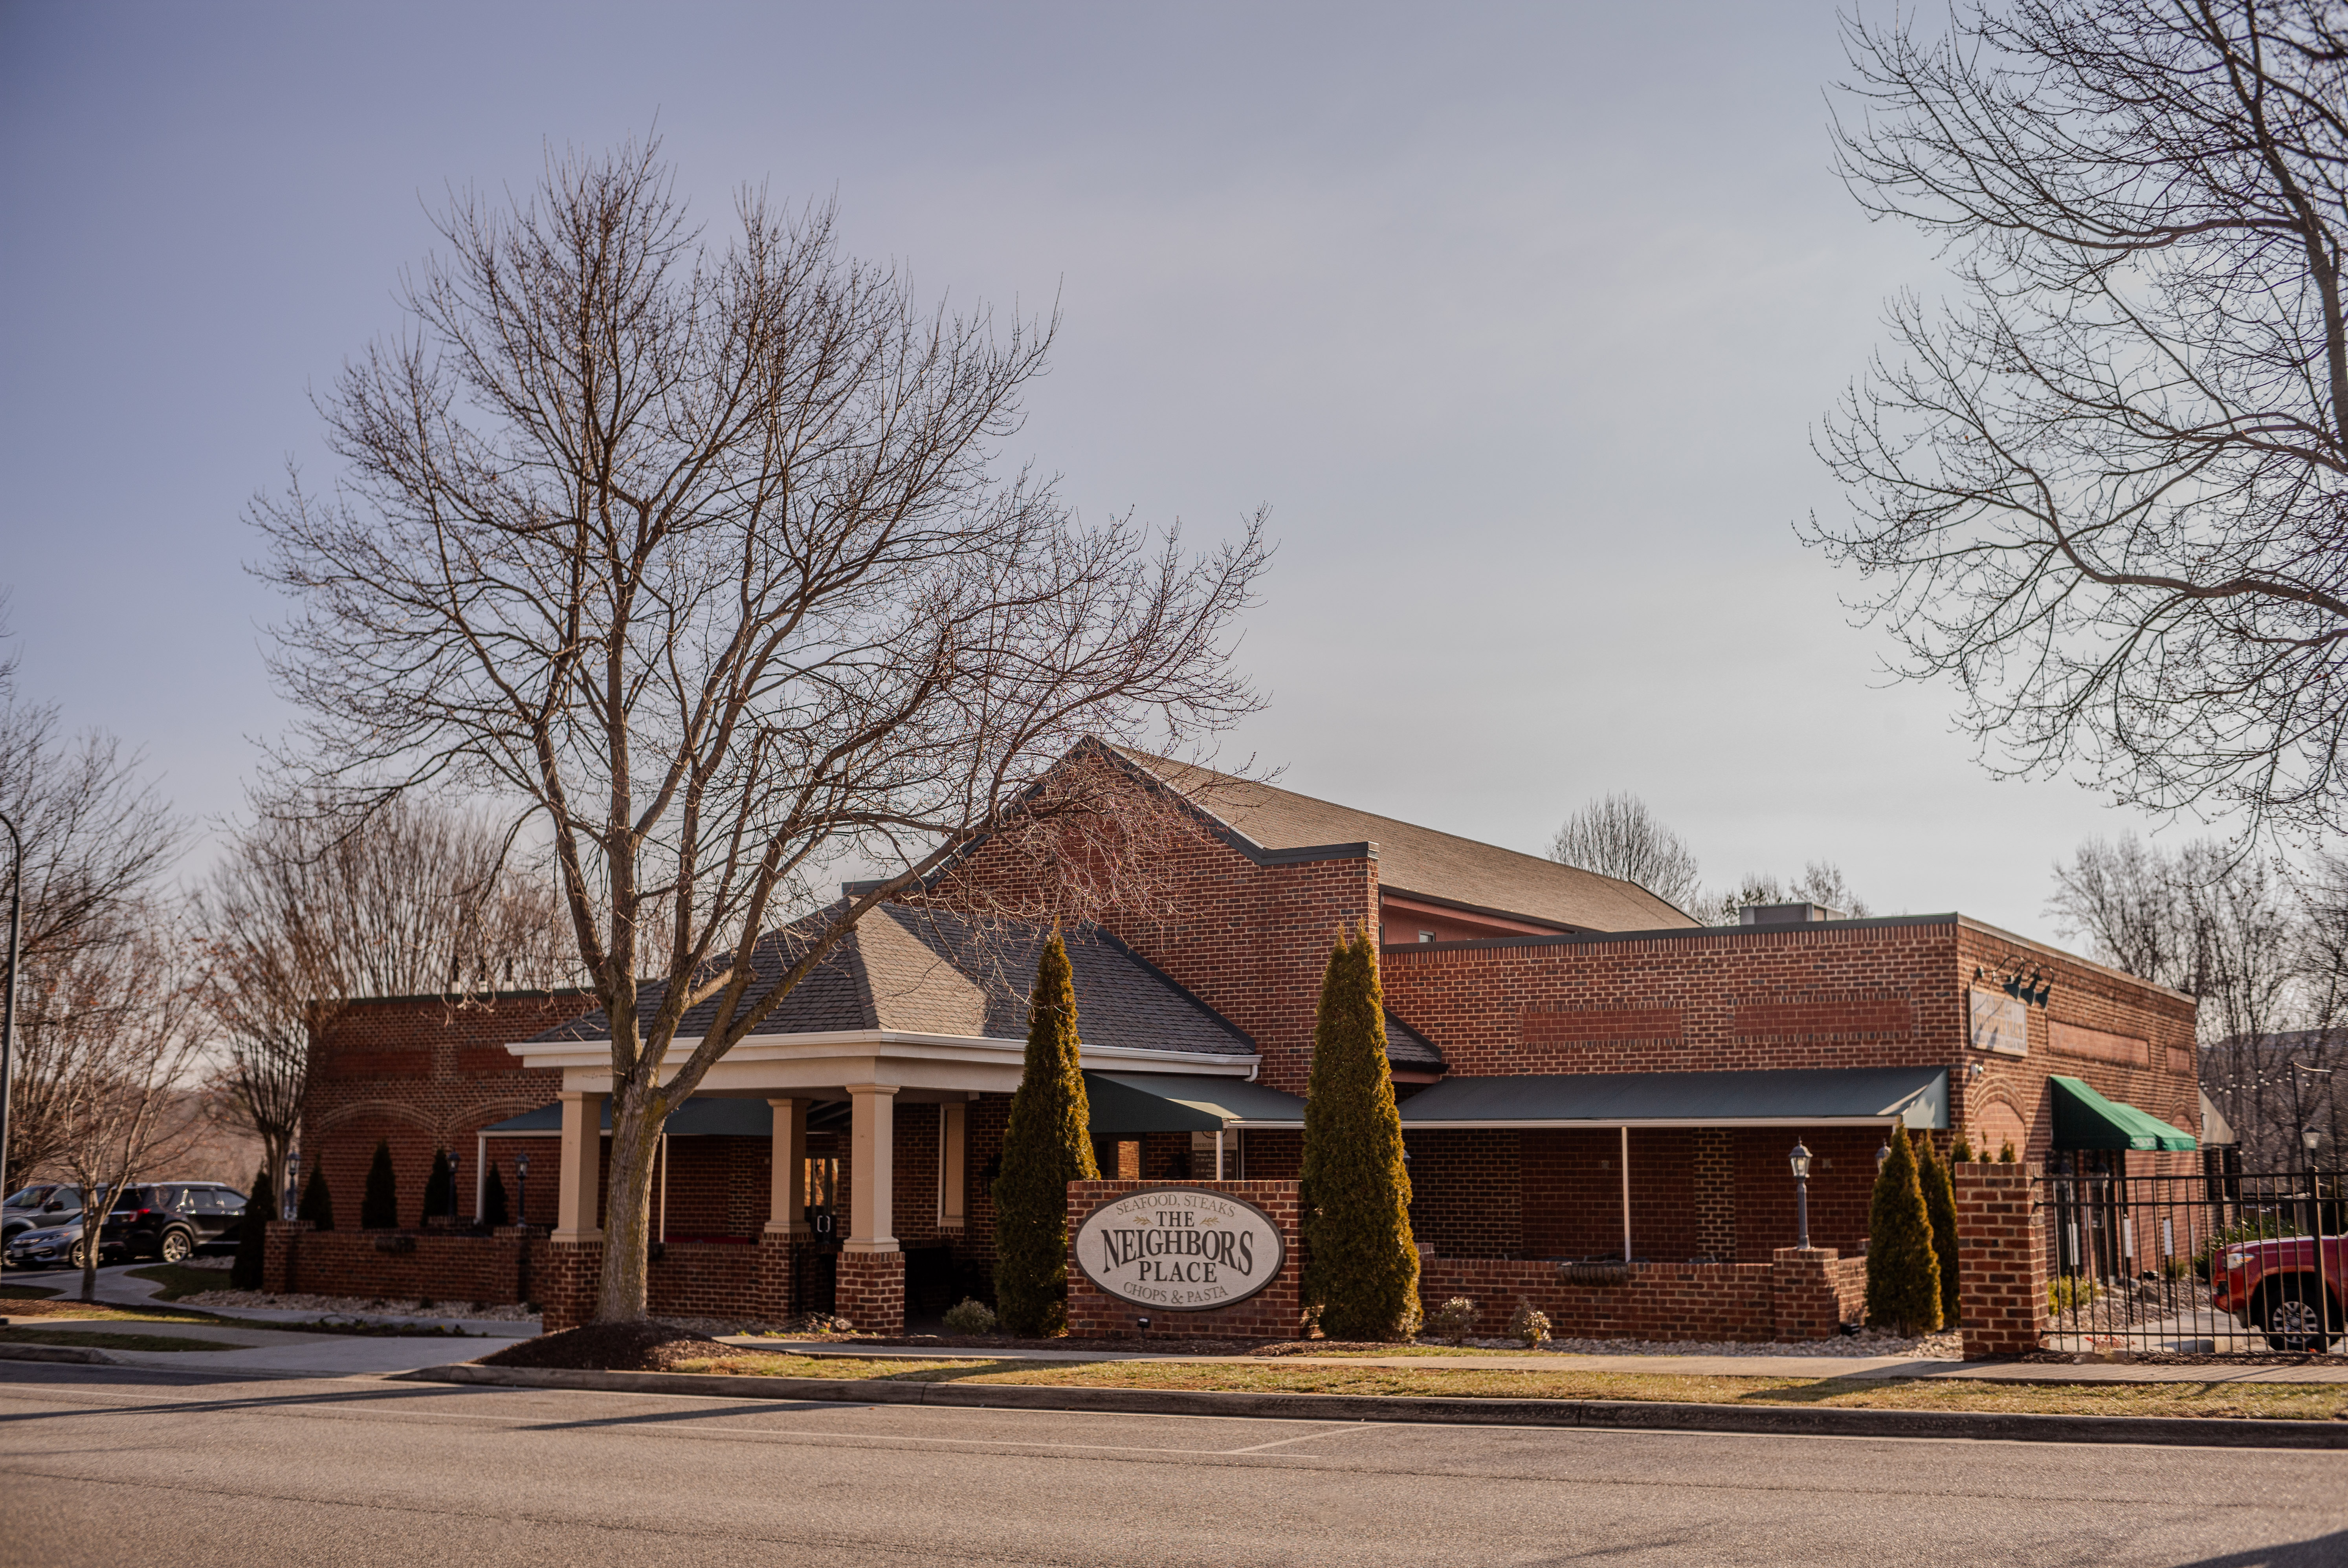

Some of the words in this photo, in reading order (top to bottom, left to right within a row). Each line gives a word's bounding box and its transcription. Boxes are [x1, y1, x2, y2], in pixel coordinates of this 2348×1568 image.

[1116, 1194, 1180, 1215] SEAFOOD,
[1184, 1195, 1236, 1217] STEAKS
[1156, 1211, 1195, 1227] THE
[1101, 1229, 1253, 1276] NEIGHBORS
[1138, 1261, 1217, 1283] PLACE
[1124, 1281, 1167, 1302] CHOPS
[1171, 1290, 1184, 1304] &
[1187, 1285, 1229, 1303] PASTA
